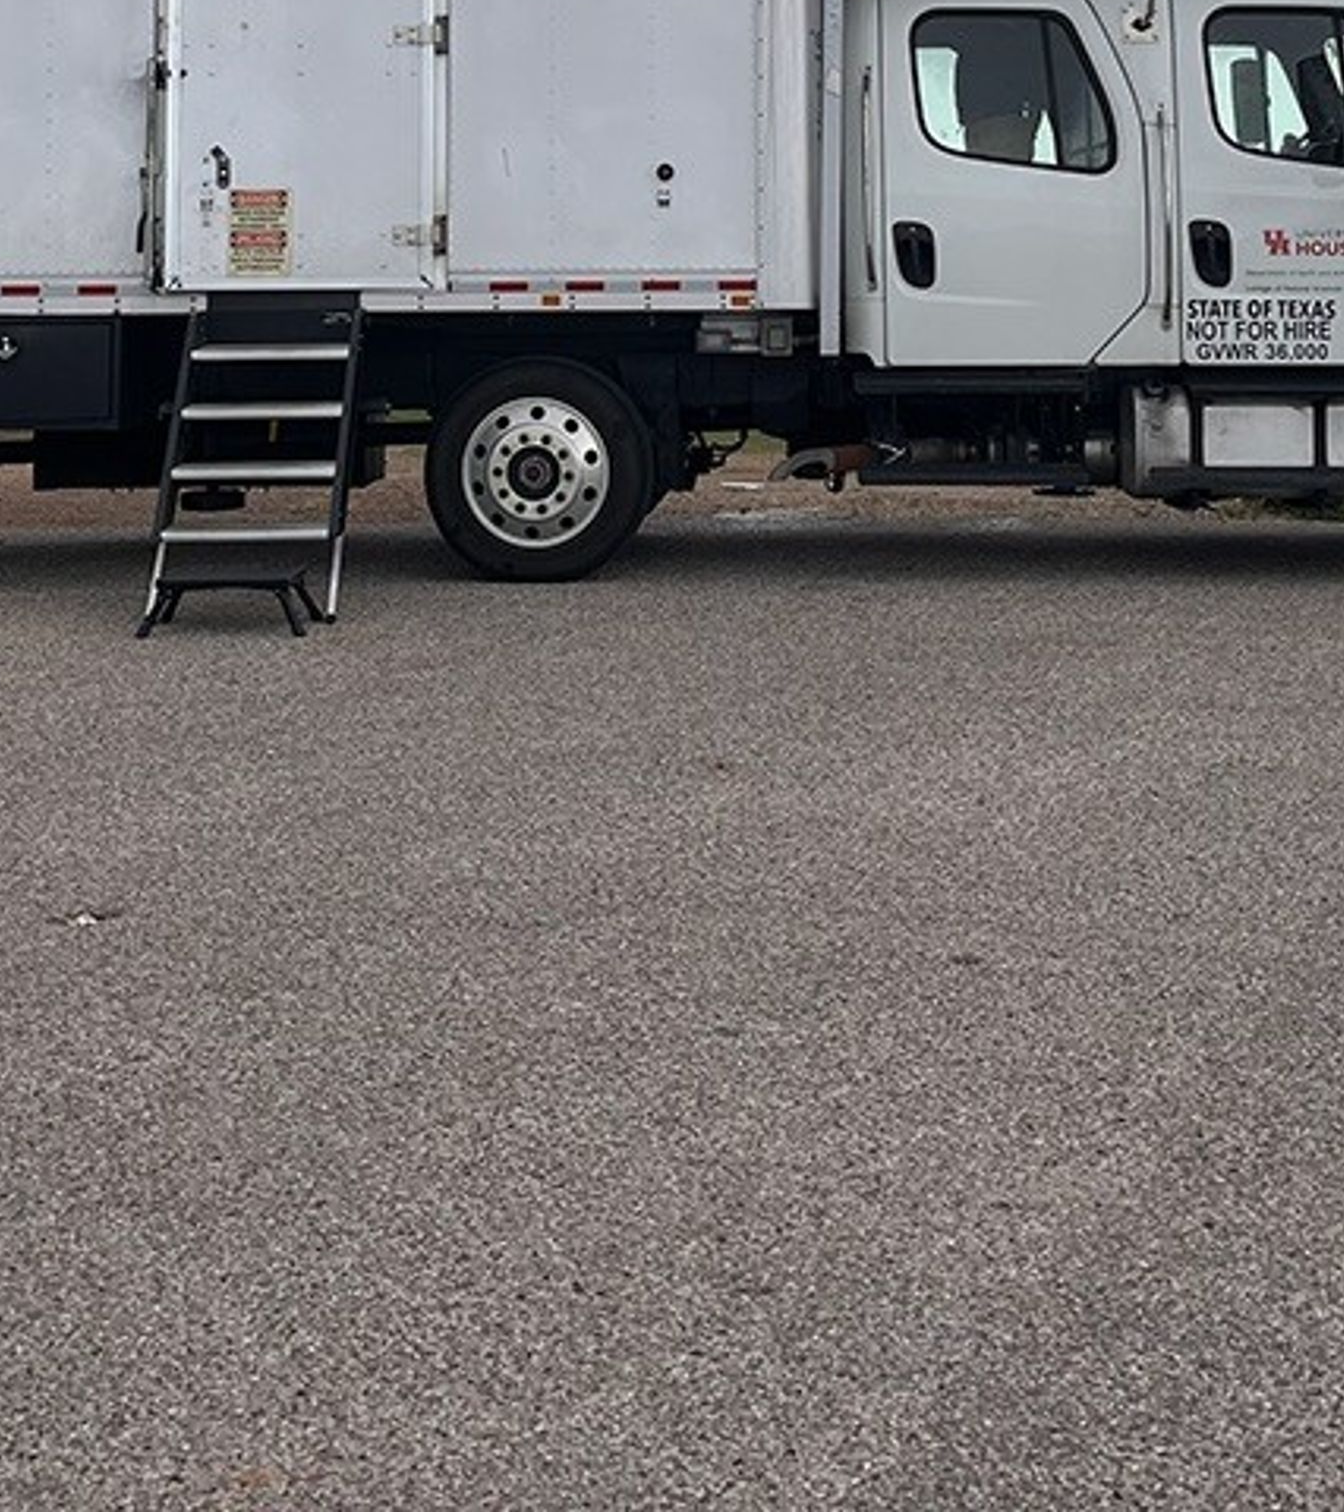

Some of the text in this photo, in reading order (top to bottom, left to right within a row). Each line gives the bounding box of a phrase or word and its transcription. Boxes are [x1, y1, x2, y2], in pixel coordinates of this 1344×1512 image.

[1187, 299, 1336, 319] STATE OF TEXAS
[1186, 321, 1331, 341] NOT FOR HIRE
[1195, 343, 1259, 361] GVWR
